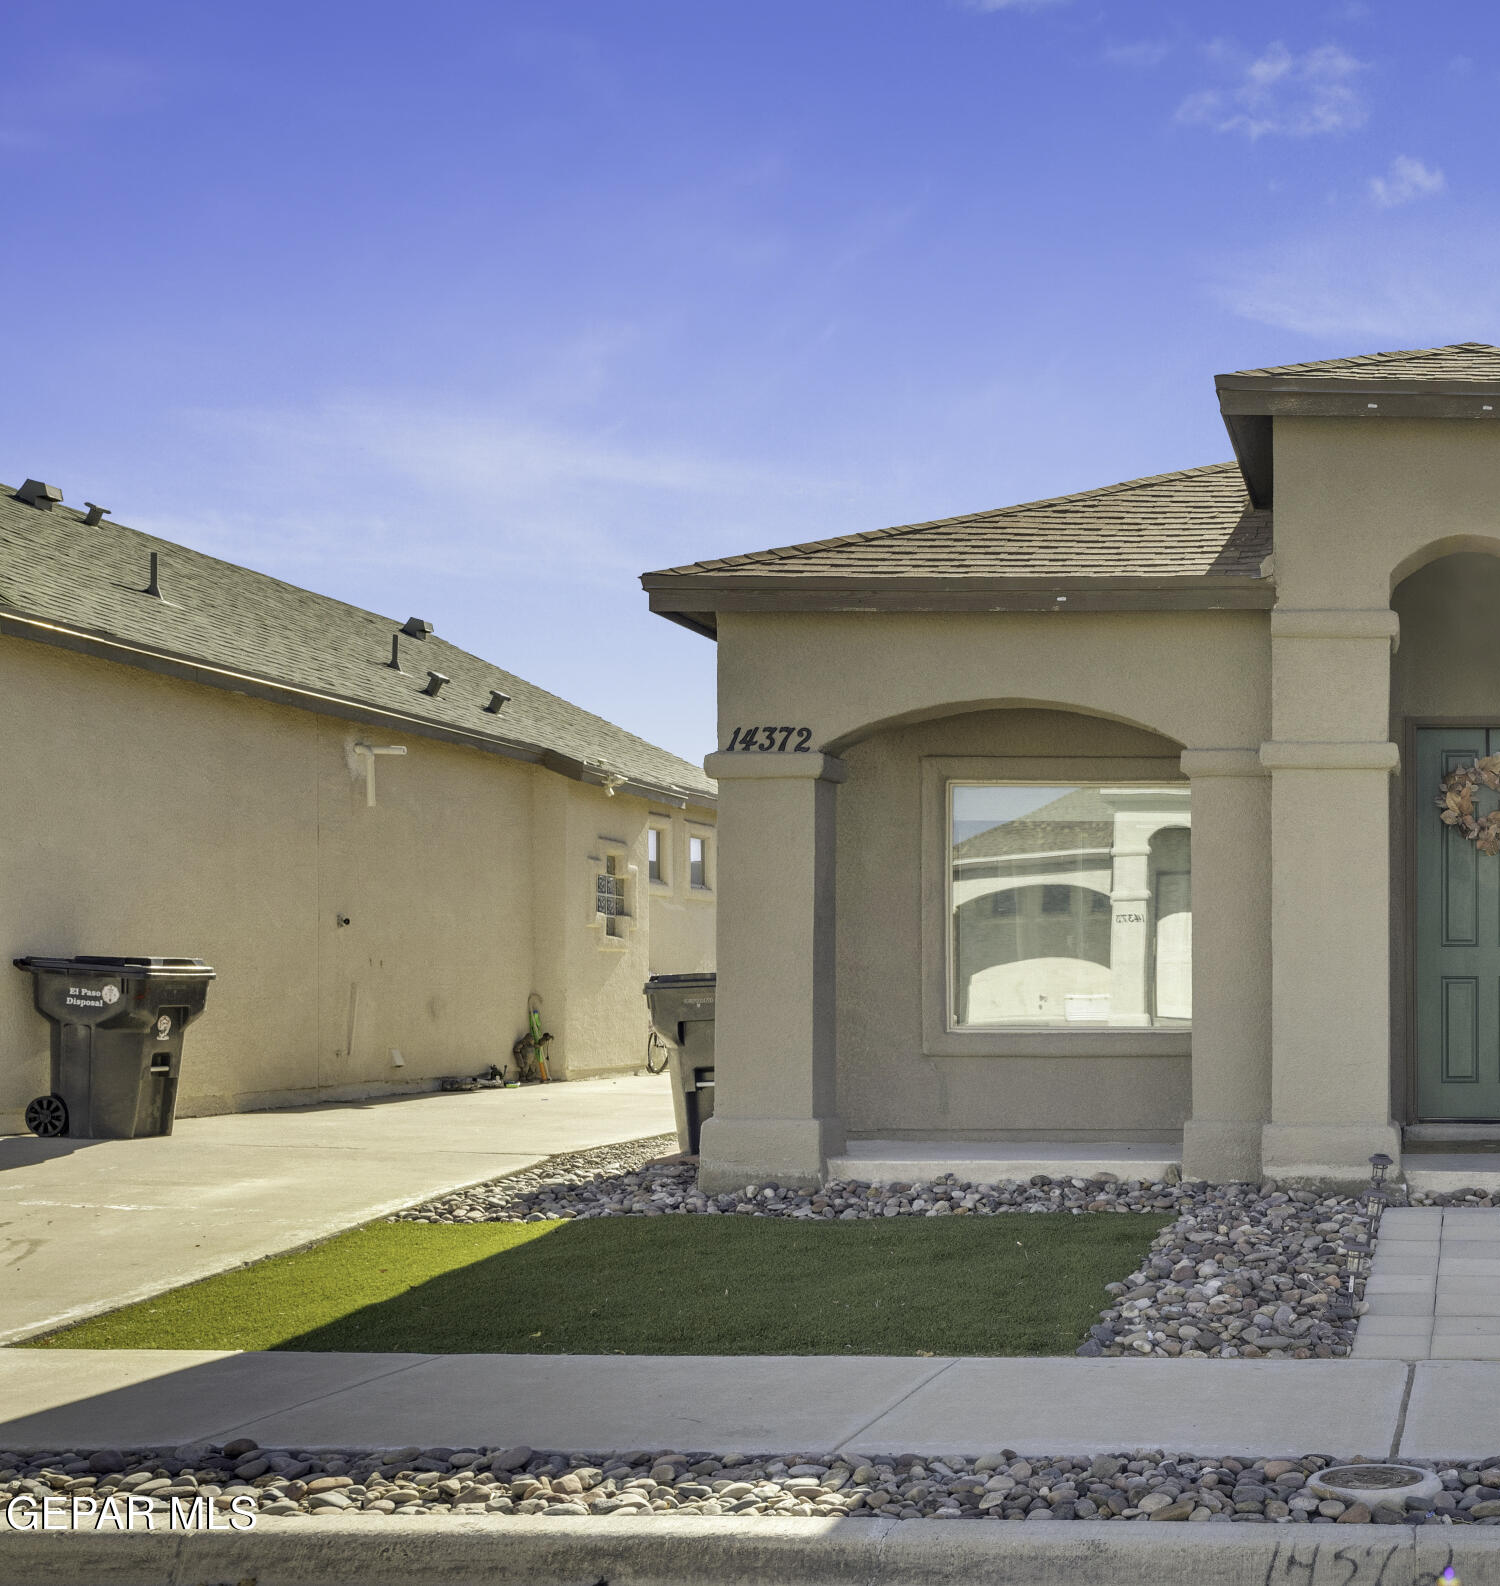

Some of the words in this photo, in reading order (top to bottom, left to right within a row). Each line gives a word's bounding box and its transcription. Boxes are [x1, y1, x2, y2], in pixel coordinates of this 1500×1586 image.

[726, 726, 813, 753] 14372
[69, 987, 79, 995] El
[81, 988, 102, 996] Paso
[66, 997, 103, 1007] Disposal
